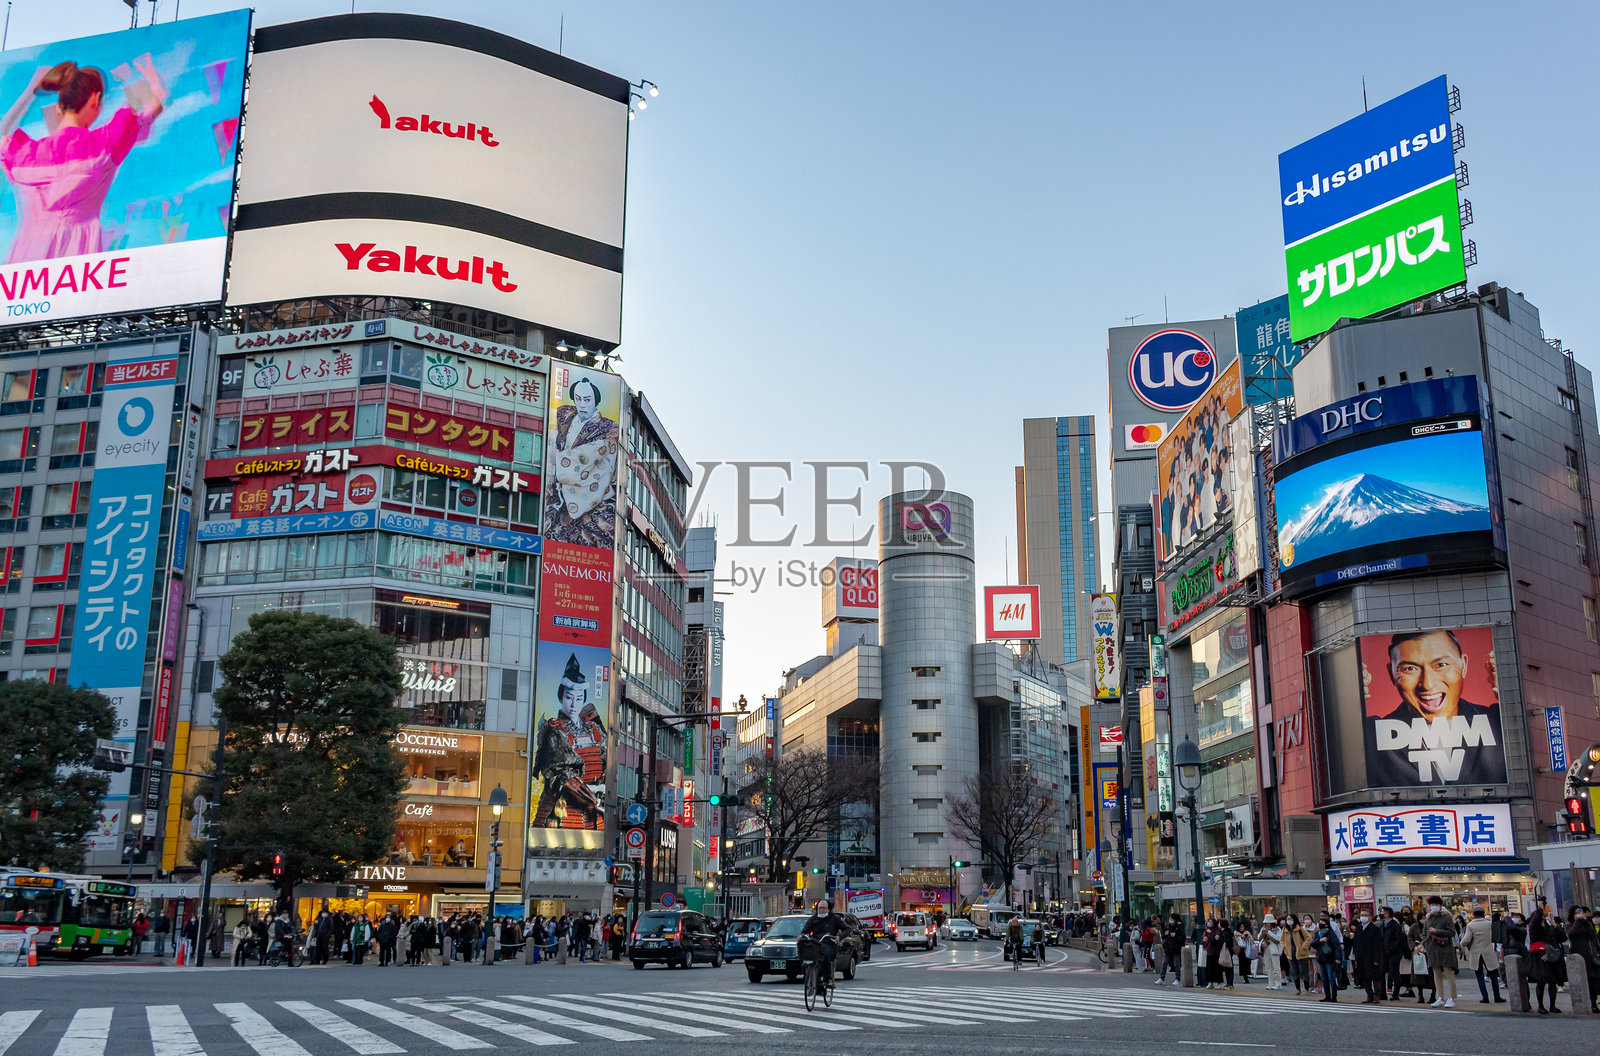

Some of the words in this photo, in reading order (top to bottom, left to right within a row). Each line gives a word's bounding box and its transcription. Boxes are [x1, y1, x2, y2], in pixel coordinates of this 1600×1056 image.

[369, 93, 500, 147] Yakult
[1283, 123, 1447, 206] Hisamitsu
[334, 243, 518, 293] Yakult
[1297, 215, 1450, 308] サロンパス
[7, 301, 51, 317] TOKYO
[234, 324, 354, 349] しゃぶしゃぶバイキング
[414, 325, 543, 367] しゃぶしゃぶバイキング
[113, 362, 171, 382] 当ビル5F
[222, 369, 243, 386] 9F
[285, 352, 353, 381] しゃぶ葉
[466, 366, 541, 403] しゃぶ葉
[243, 410, 351, 442] プライス
[386, 408, 510, 451] コンタクト
[1321, 396, 1383, 435] DHC
[1414, 424, 1446, 434] DHCビール
[105, 439, 160, 459] eyecity
[304, 448, 359, 473] ガスト
[351, 487, 374, 496] ガスト
[472, 465, 529, 492] ガスト
[208, 493, 233, 511] 7F
[239, 489, 268, 503] Café
[270, 481, 338, 514] ガスト
[203, 523, 236, 536] AEON
[246, 516, 345, 536] 英会話イーオン
[385, 514, 424, 531] AEON
[433, 520, 539, 550] 英会話イーオン
[896, 503, 951, 541] 109
[85, 496, 128, 652] アイシティ
[115, 494, 152, 650] コンタクトの
[543, 561, 611, 583] SANEMORI
[1337, 568, 1357, 580] DHC
[1358, 560, 1397, 575] Channel
[847, 589, 877, 604] QLO
[999, 603, 1026, 621] H&M
[1375, 714, 1497, 751] DMM
[1549, 711, 1564, 770] 大盛堂商事ビル
[1408, 749, 1466, 783] TV
[405, 804, 433, 818] Café
[661, 828, 677, 849] LUSH
[1335, 813, 1495, 851] 大盛堂書店
[921, 890, 937, 902] 109
